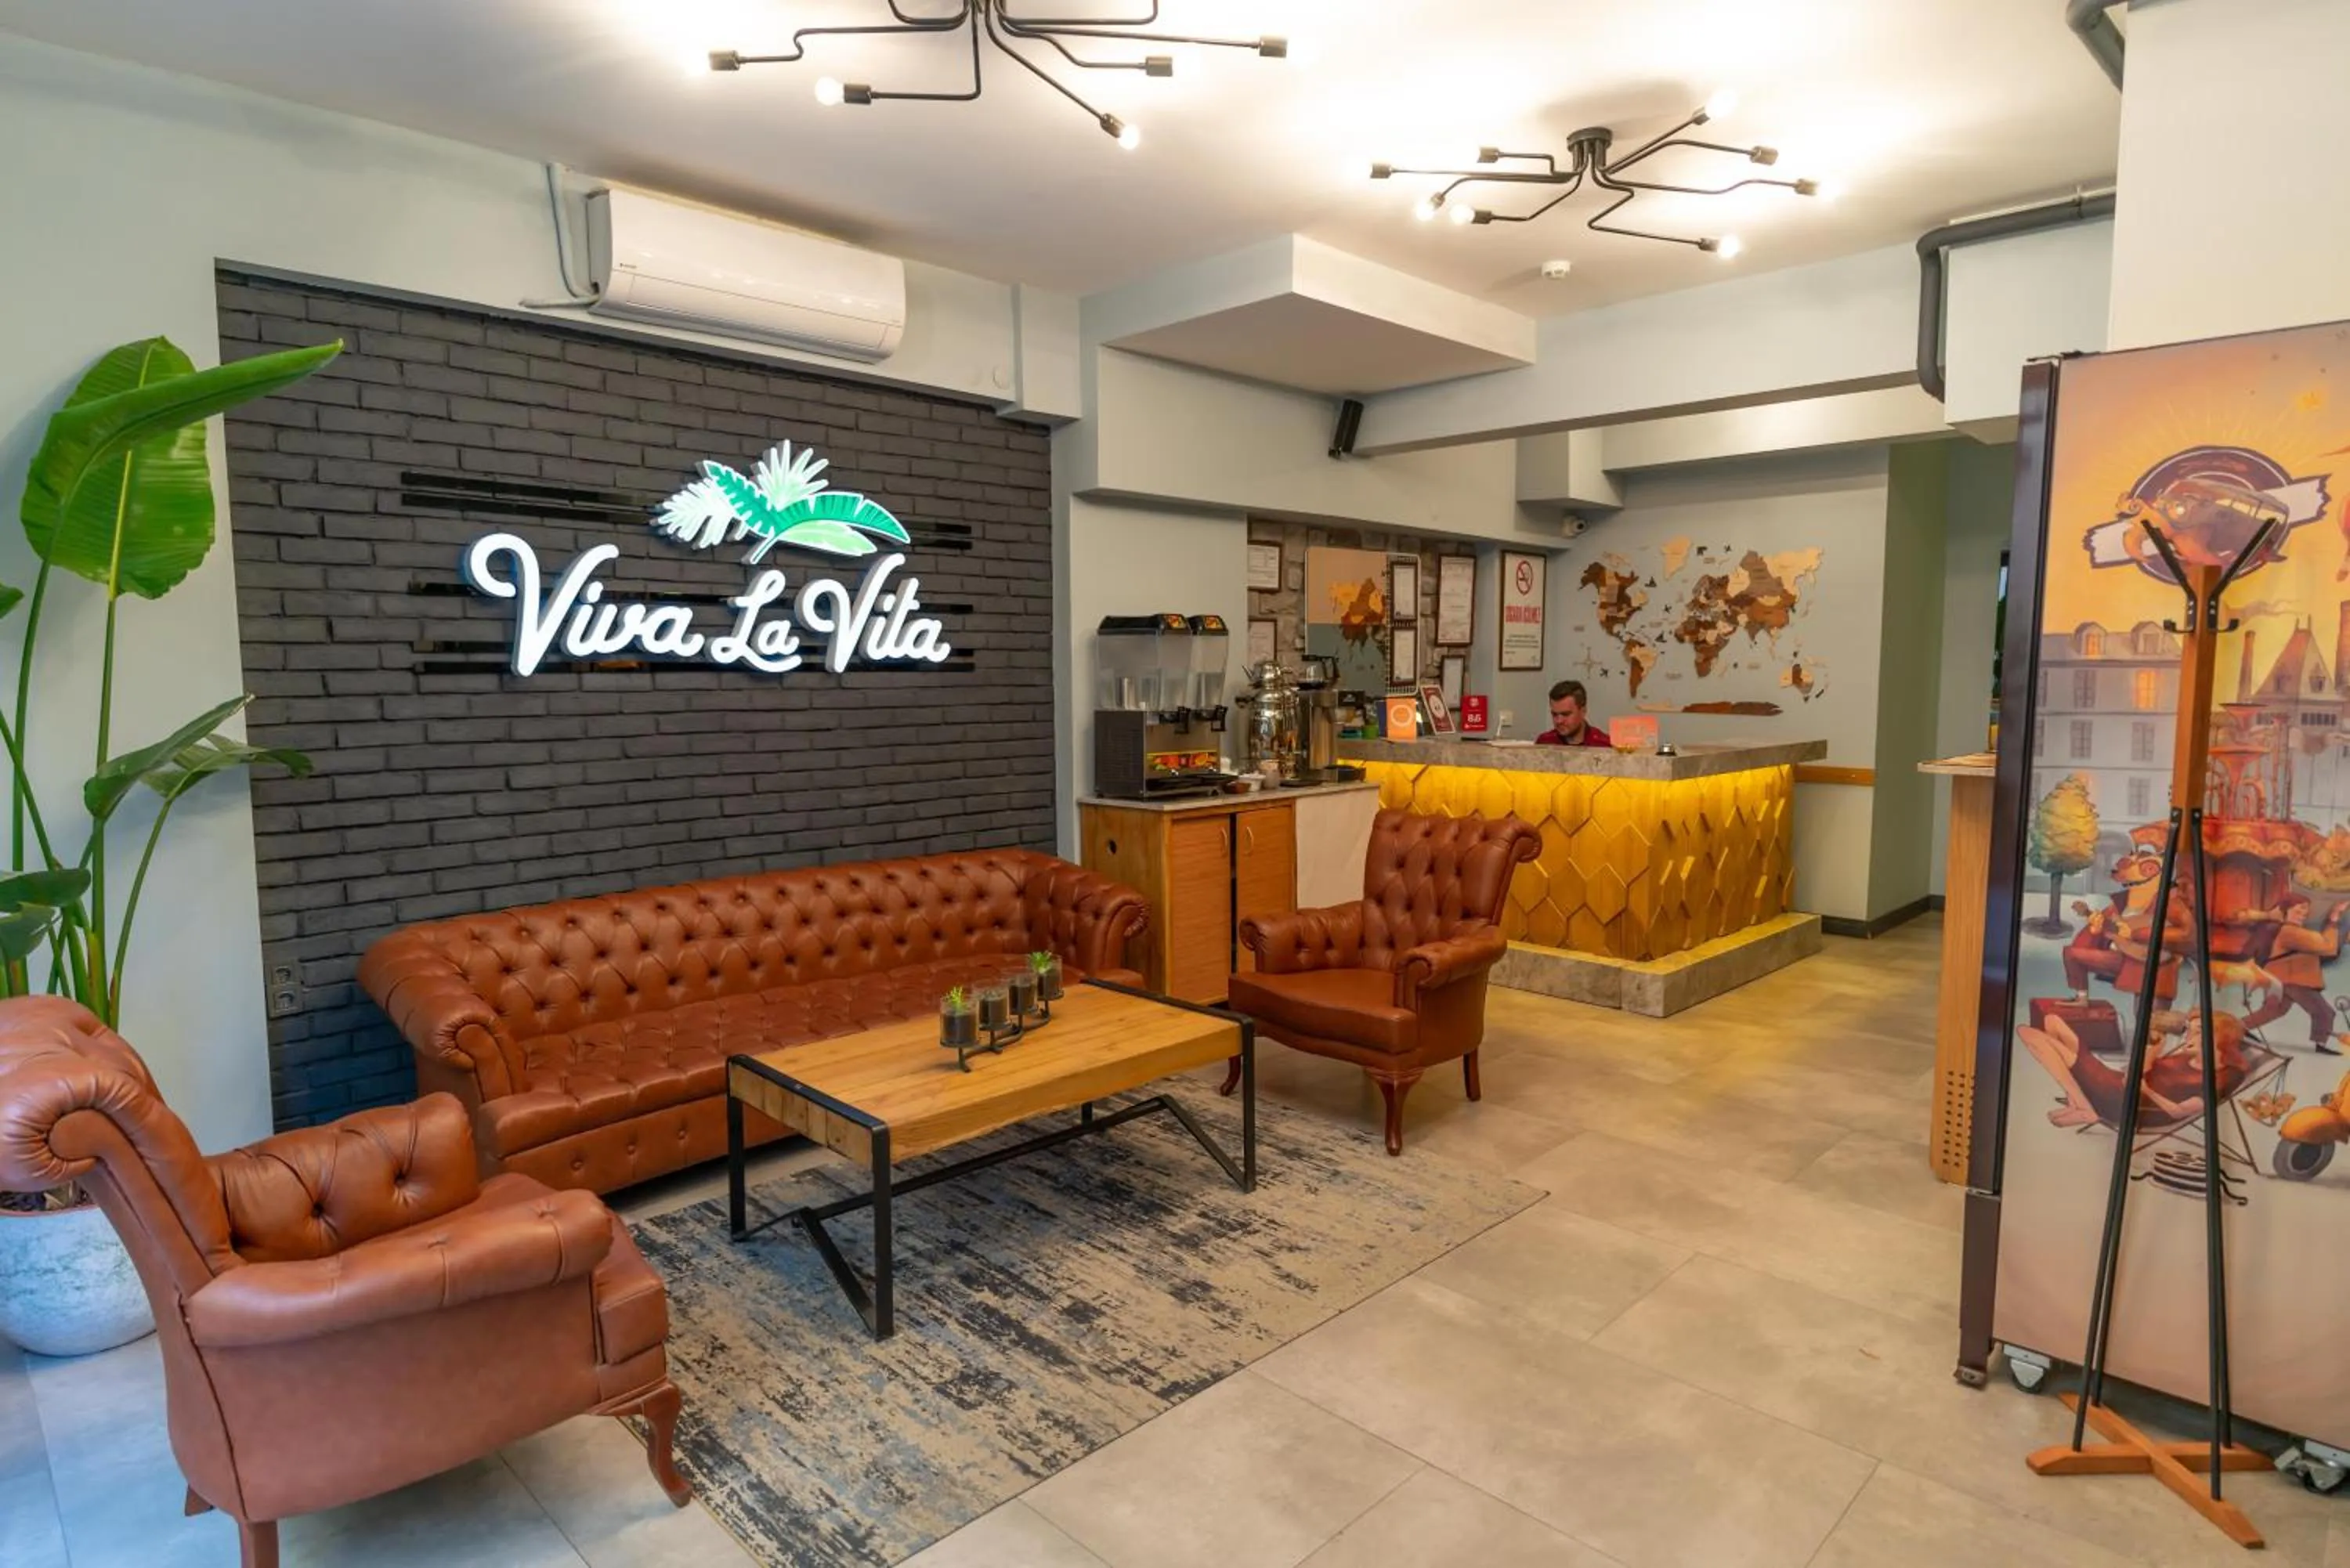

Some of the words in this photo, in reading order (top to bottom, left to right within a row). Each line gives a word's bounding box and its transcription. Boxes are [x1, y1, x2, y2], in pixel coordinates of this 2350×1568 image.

[469, 533, 704, 677] Viva
[710, 569, 802, 673] La
[798, 553, 951, 674] Vita
